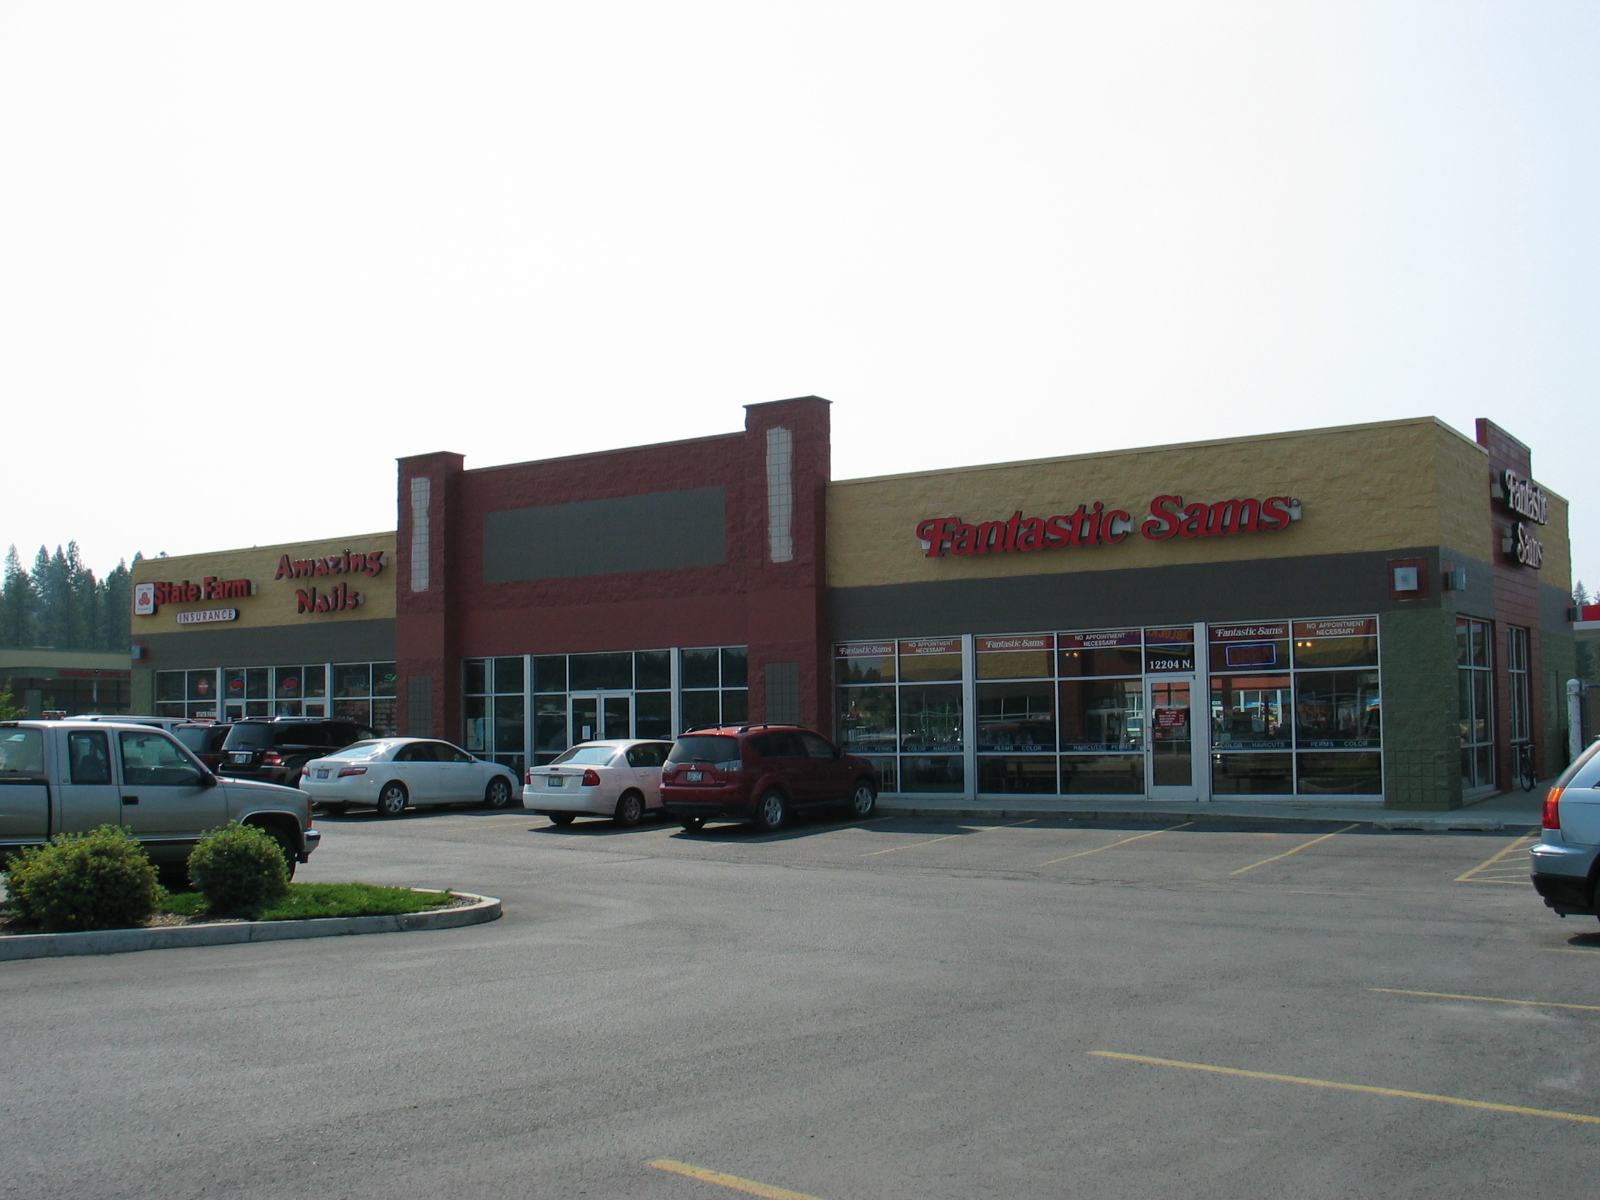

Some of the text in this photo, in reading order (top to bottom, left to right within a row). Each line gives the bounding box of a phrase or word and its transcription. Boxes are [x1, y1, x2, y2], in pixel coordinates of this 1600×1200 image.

[1505, 469, 1547, 525] Fantastic
[916, 494, 1291, 558] Fantastic Sams
[275, 549, 384, 580] Amazing
[155, 576, 251, 605] State Farm
[295, 582, 360, 614] Nails
[178, 609, 234, 623] INSURANCE
[1318, 620, 1364, 628] APPOINTMENT
[1085, 632, 1125, 640] APPOINTMENT
[1215, 626, 1283, 638] Fantastic Sams
[1316, 628, 1355, 636] NECESSARY
[986, 638, 1044, 650] Fantastic Sams
[1083, 639, 1117, 647] NECESSARY
[839, 644, 892, 655] Fantastic Sams
[1149, 659, 1193, 670] 12204 N.
